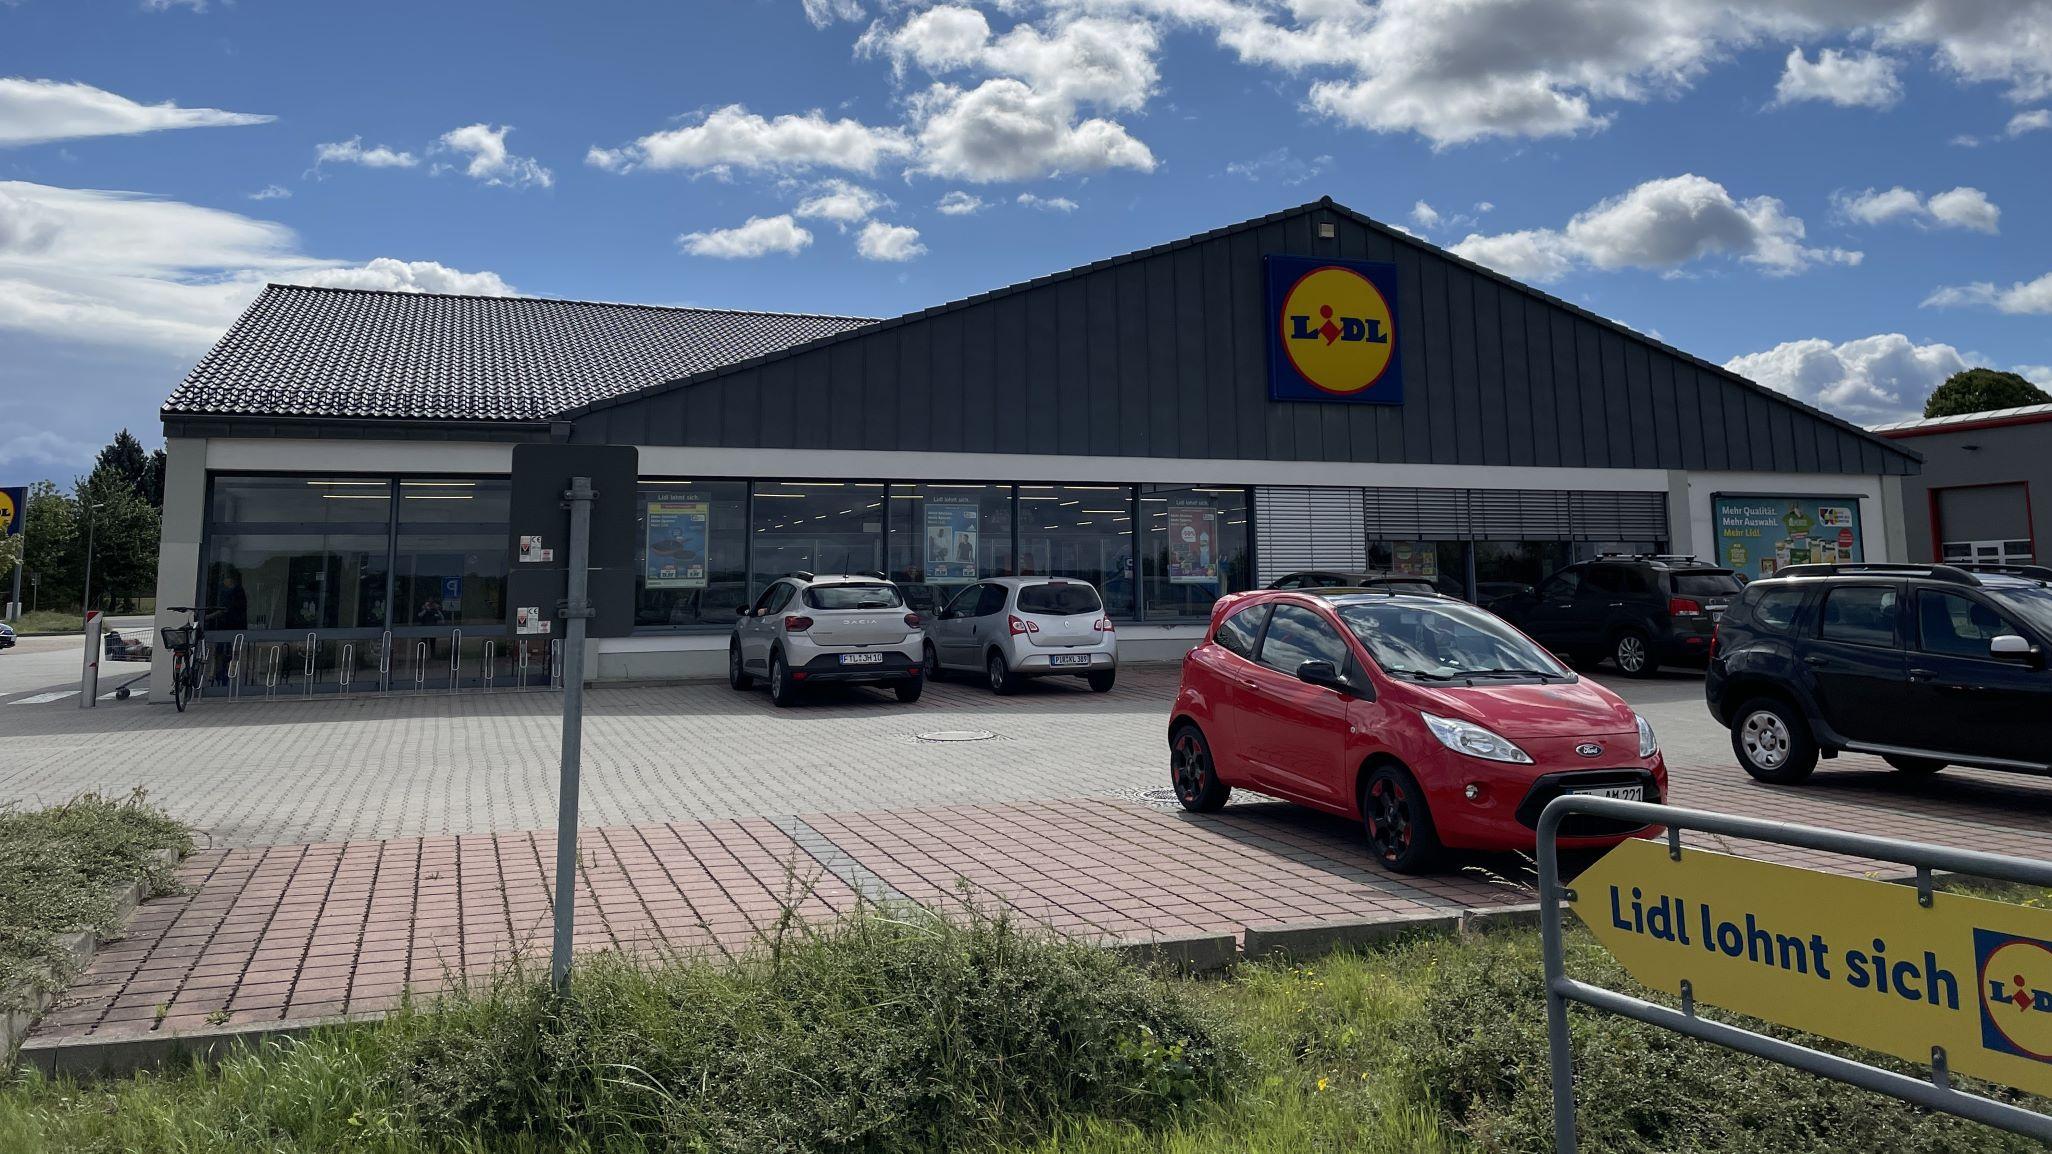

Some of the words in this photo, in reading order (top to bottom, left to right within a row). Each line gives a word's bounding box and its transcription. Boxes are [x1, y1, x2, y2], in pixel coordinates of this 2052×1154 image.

[1290, 304, 1388, 346] LIDL
[1722, 505, 1742, 515] Mehr
[1743, 505, 1777, 516] Qualität.
[1723, 517, 1744, 526] Mehr
[1744, 517, 1779, 526] Auswahl.
[1724, 528, 1744, 536] Mehr
[1583, 744, 1598, 753] Ford
[1609, 885, 1690, 946] Lidl
[1700, 903, 1831, 980] lohnt
[1845, 937, 1960, 1010] sich
[1988, 974, 2052, 1013] LID
